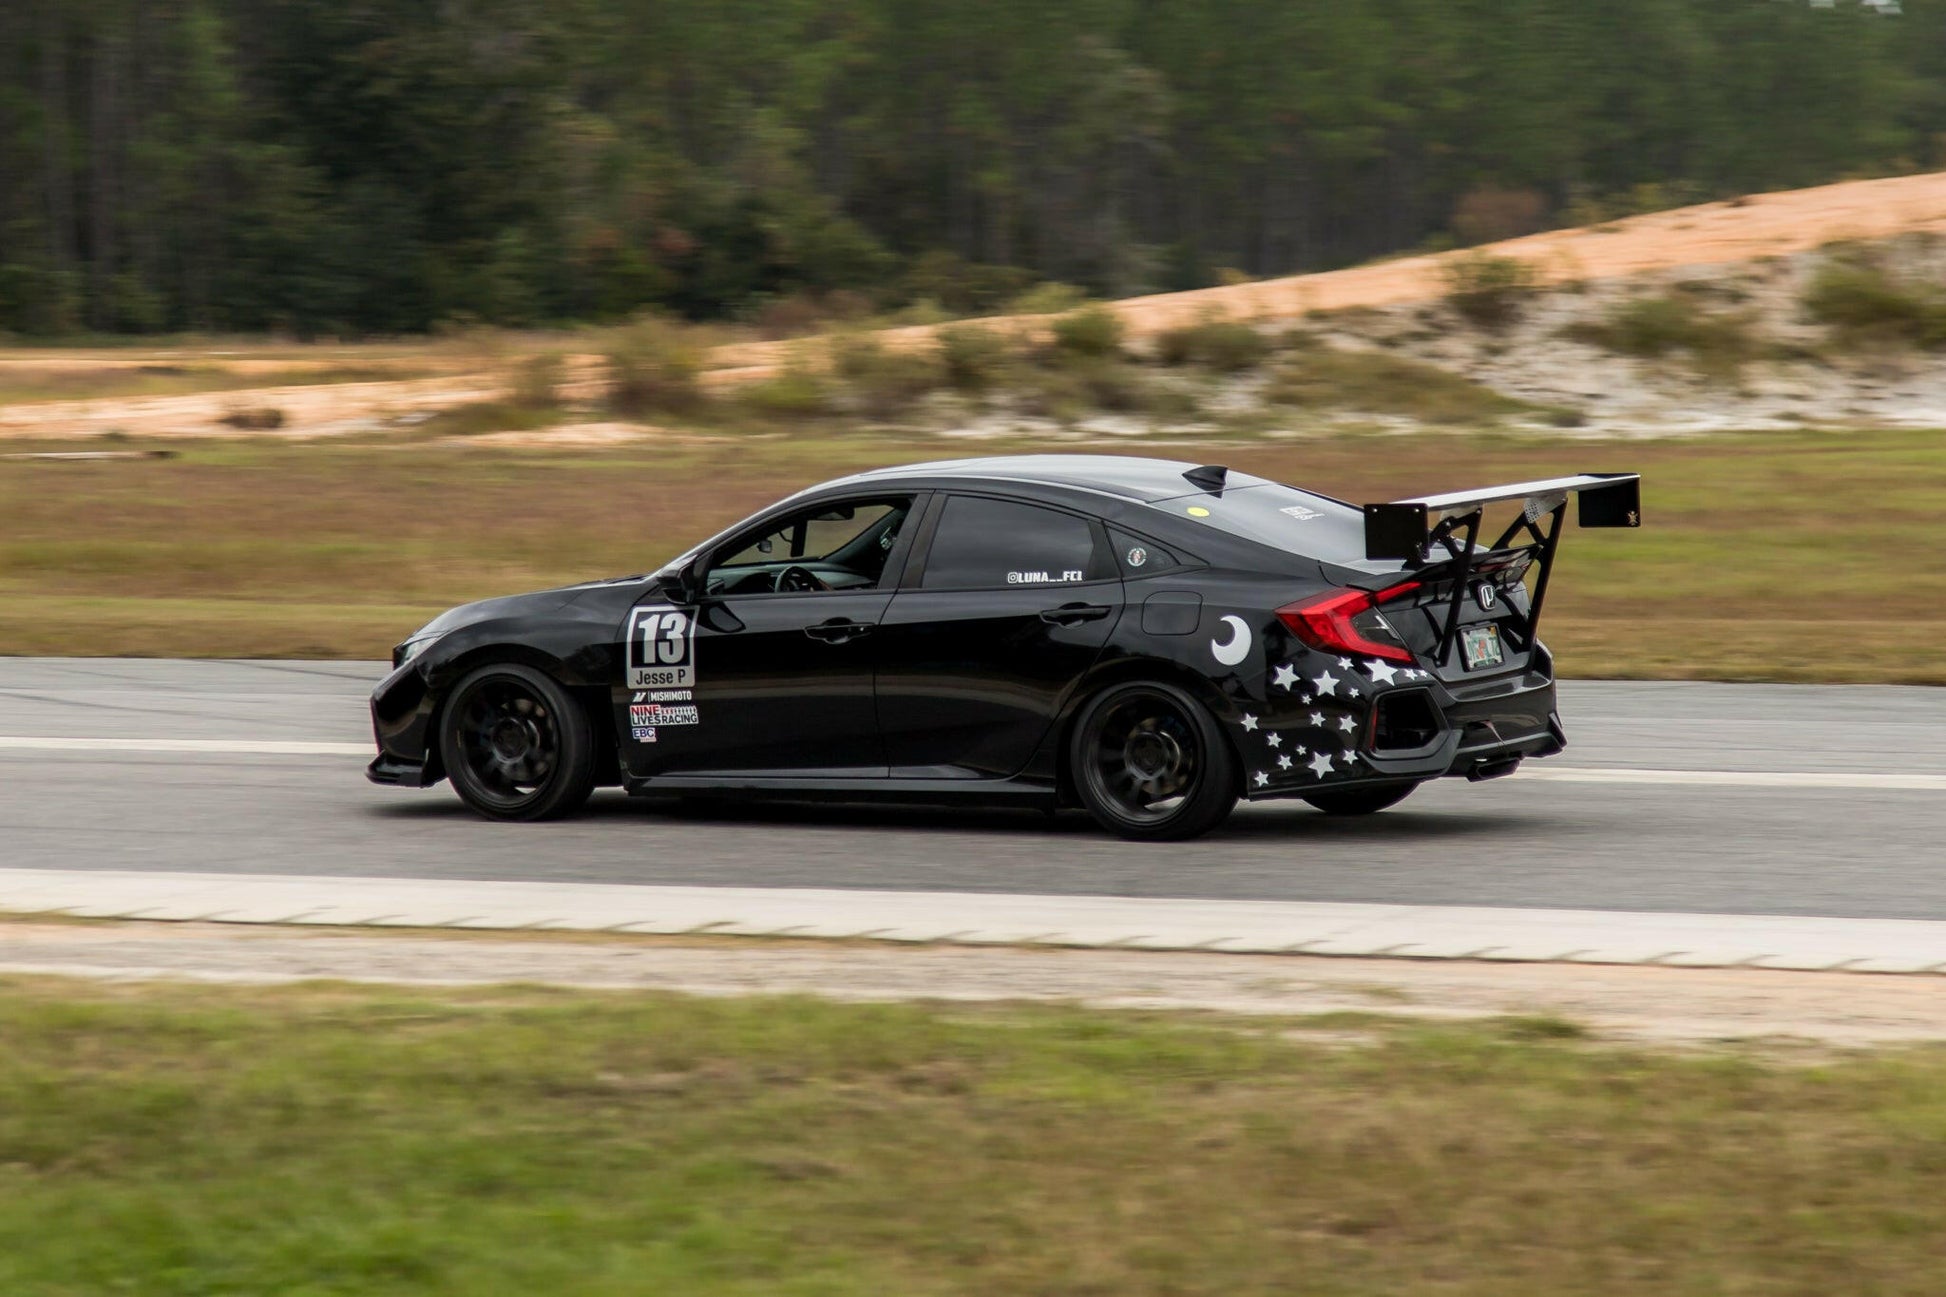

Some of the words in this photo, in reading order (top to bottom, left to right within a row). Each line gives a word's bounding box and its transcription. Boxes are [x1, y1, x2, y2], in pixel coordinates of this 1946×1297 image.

[638, 613, 687, 664] 13
[636, 670, 673, 685] Jesse
[678, 669, 686, 683] P
[650, 690, 692, 702] MISHIMOTO
[631, 705, 659, 716] NINE
[633, 728, 654, 738] EBC
